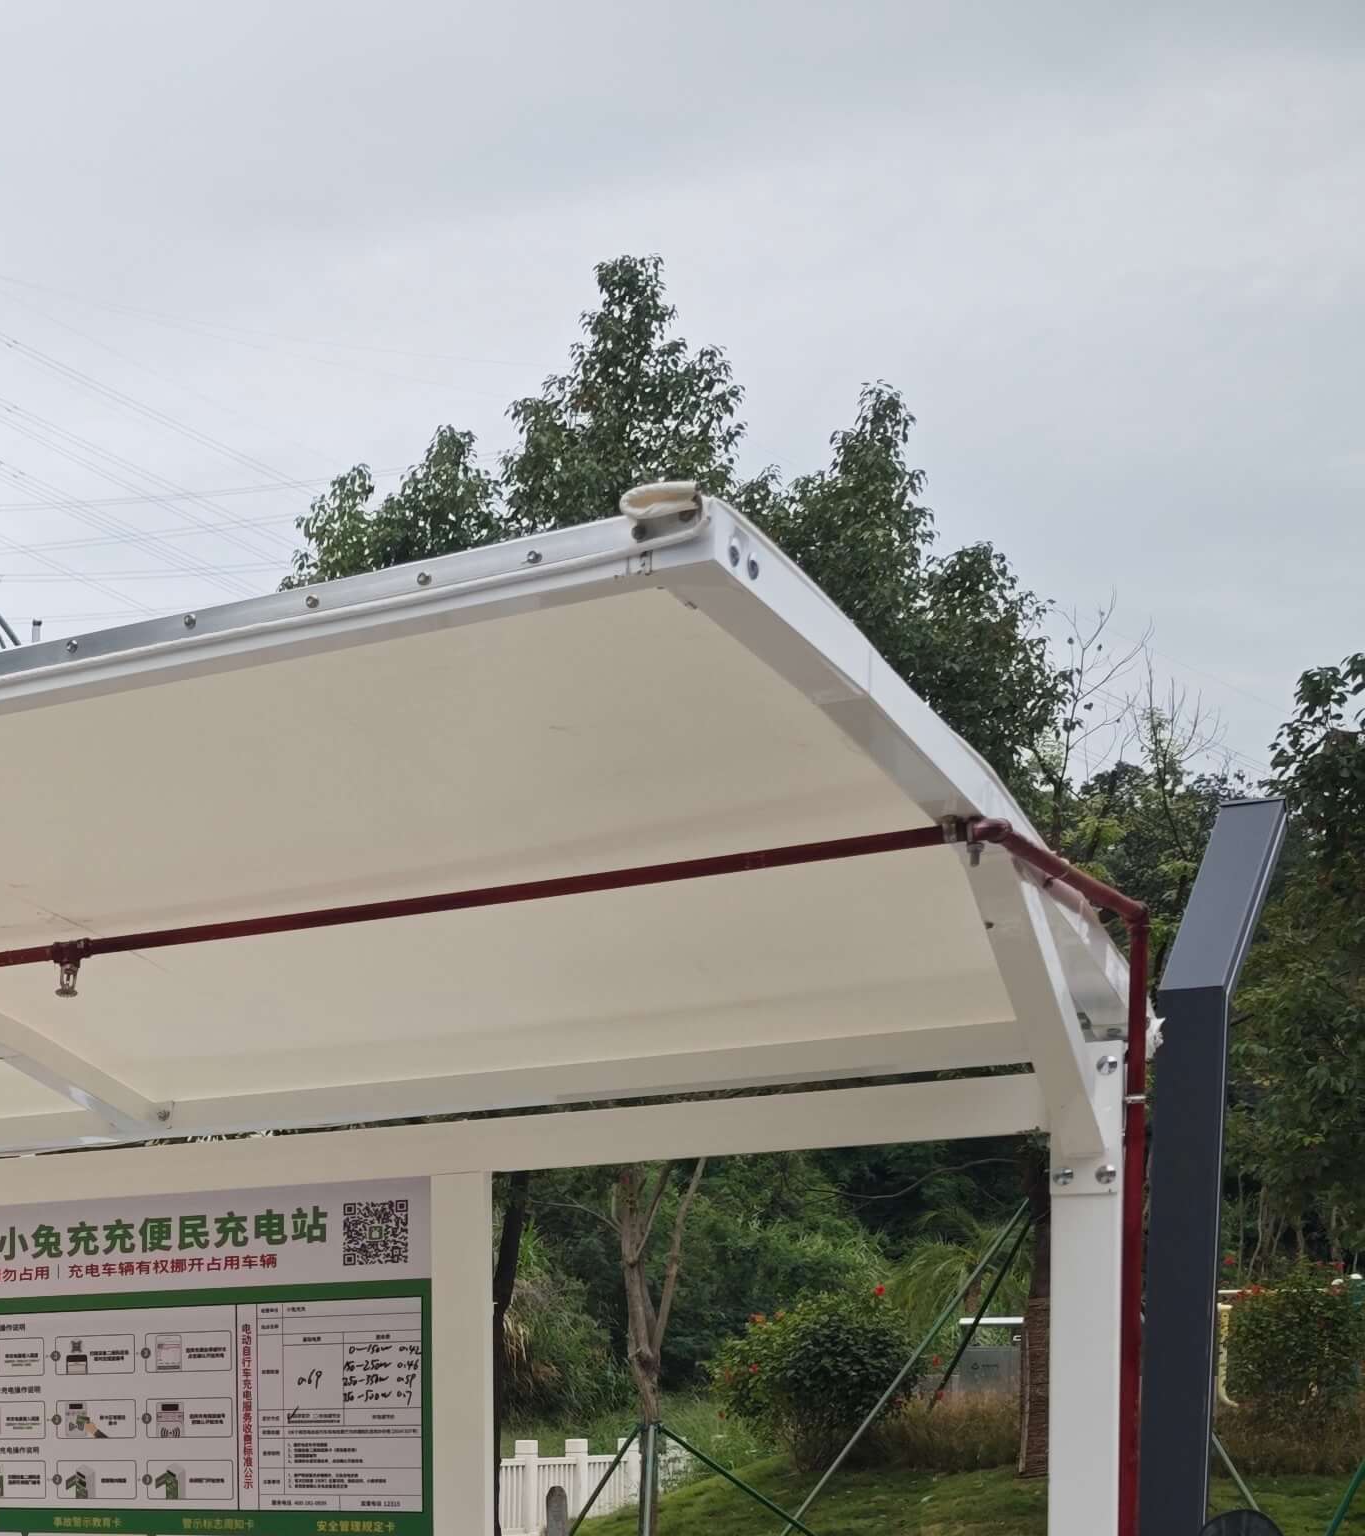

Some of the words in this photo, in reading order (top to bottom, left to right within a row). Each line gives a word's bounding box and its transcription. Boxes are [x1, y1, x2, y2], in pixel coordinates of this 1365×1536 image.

[68, 1253, 278, 1280] 充电车辆有权挪开占用车辆
[241, 1323, 254, 1490] 电动自行车充电服务收费标准公示
